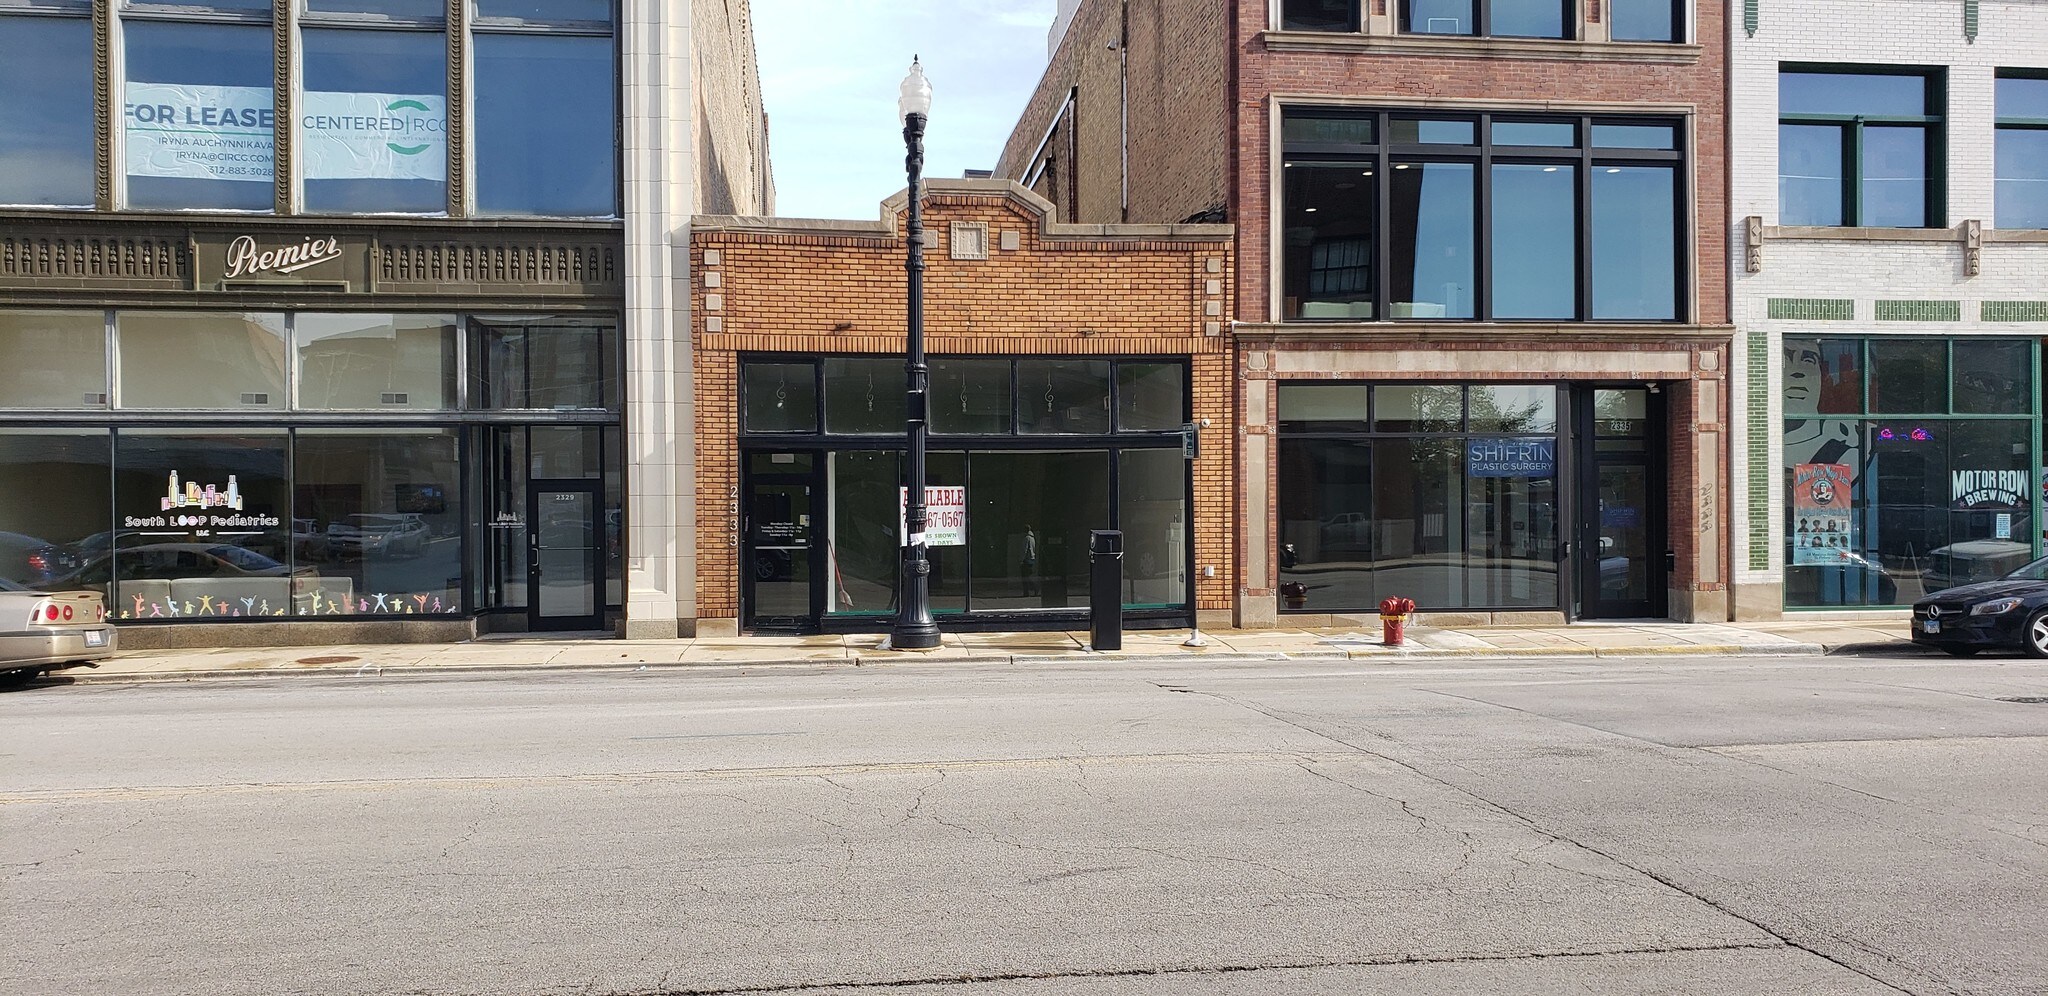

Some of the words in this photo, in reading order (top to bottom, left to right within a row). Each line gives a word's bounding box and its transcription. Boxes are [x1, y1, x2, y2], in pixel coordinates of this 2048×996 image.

[125, 104, 175, 124] FOR
[186, 106, 274, 128] LEASE
[302, 115, 404, 131] CENTERED
[158, 137, 189, 146] IRYNA
[193, 138, 274, 149] AUCHYNNIKAVA
[176, 151, 274, 163] IRYNA@CIRCG.COM
[209, 165, 274, 177] 312-883-3028
[225, 235, 342, 278] Premier
[1610, 421, 1632, 431] 2335
[1471, 445, 1553, 461] SHIFRIN
[1471, 463, 1509, 471] PLASTIC
[1511, 463, 1553, 471] SURGERY
[1952, 470, 1997, 501] MOTOR
[1998, 470, 2029, 500] ROW
[903, 489, 964, 507] AILABLE
[1964, 489, 2017, 507] BREWING
[125, 515, 165, 527] South
[211, 513, 279, 527] Pediatrics
